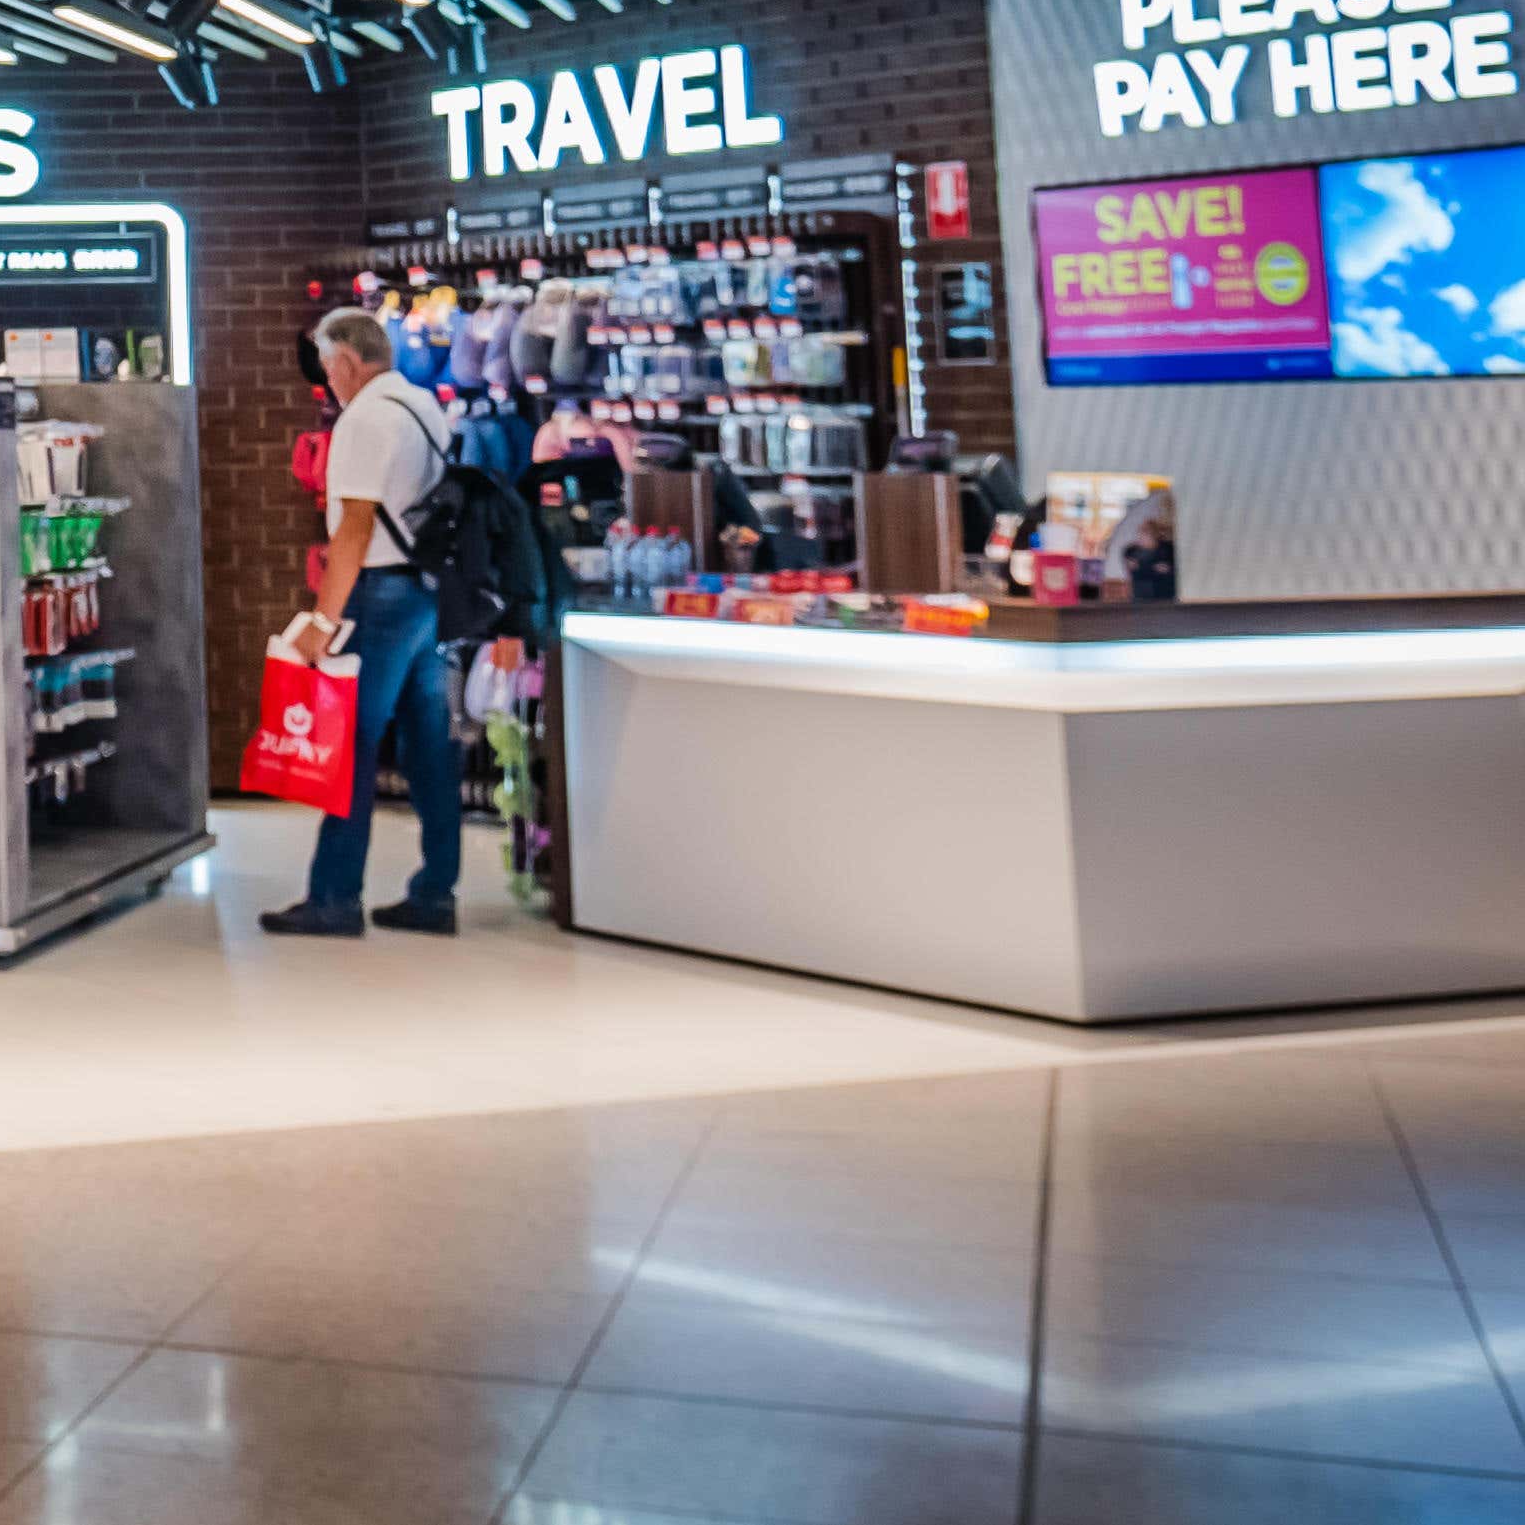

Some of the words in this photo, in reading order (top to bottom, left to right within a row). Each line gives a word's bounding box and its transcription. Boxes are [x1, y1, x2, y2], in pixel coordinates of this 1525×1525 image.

[431, 43, 782, 180] TRAVEL
[1093, 44, 1249, 137] PAY
[1268, 11, 1518, 118] HERE
[1095, 184, 1245, 243] SAVE!
[1052, 247, 1169, 298] FREE
